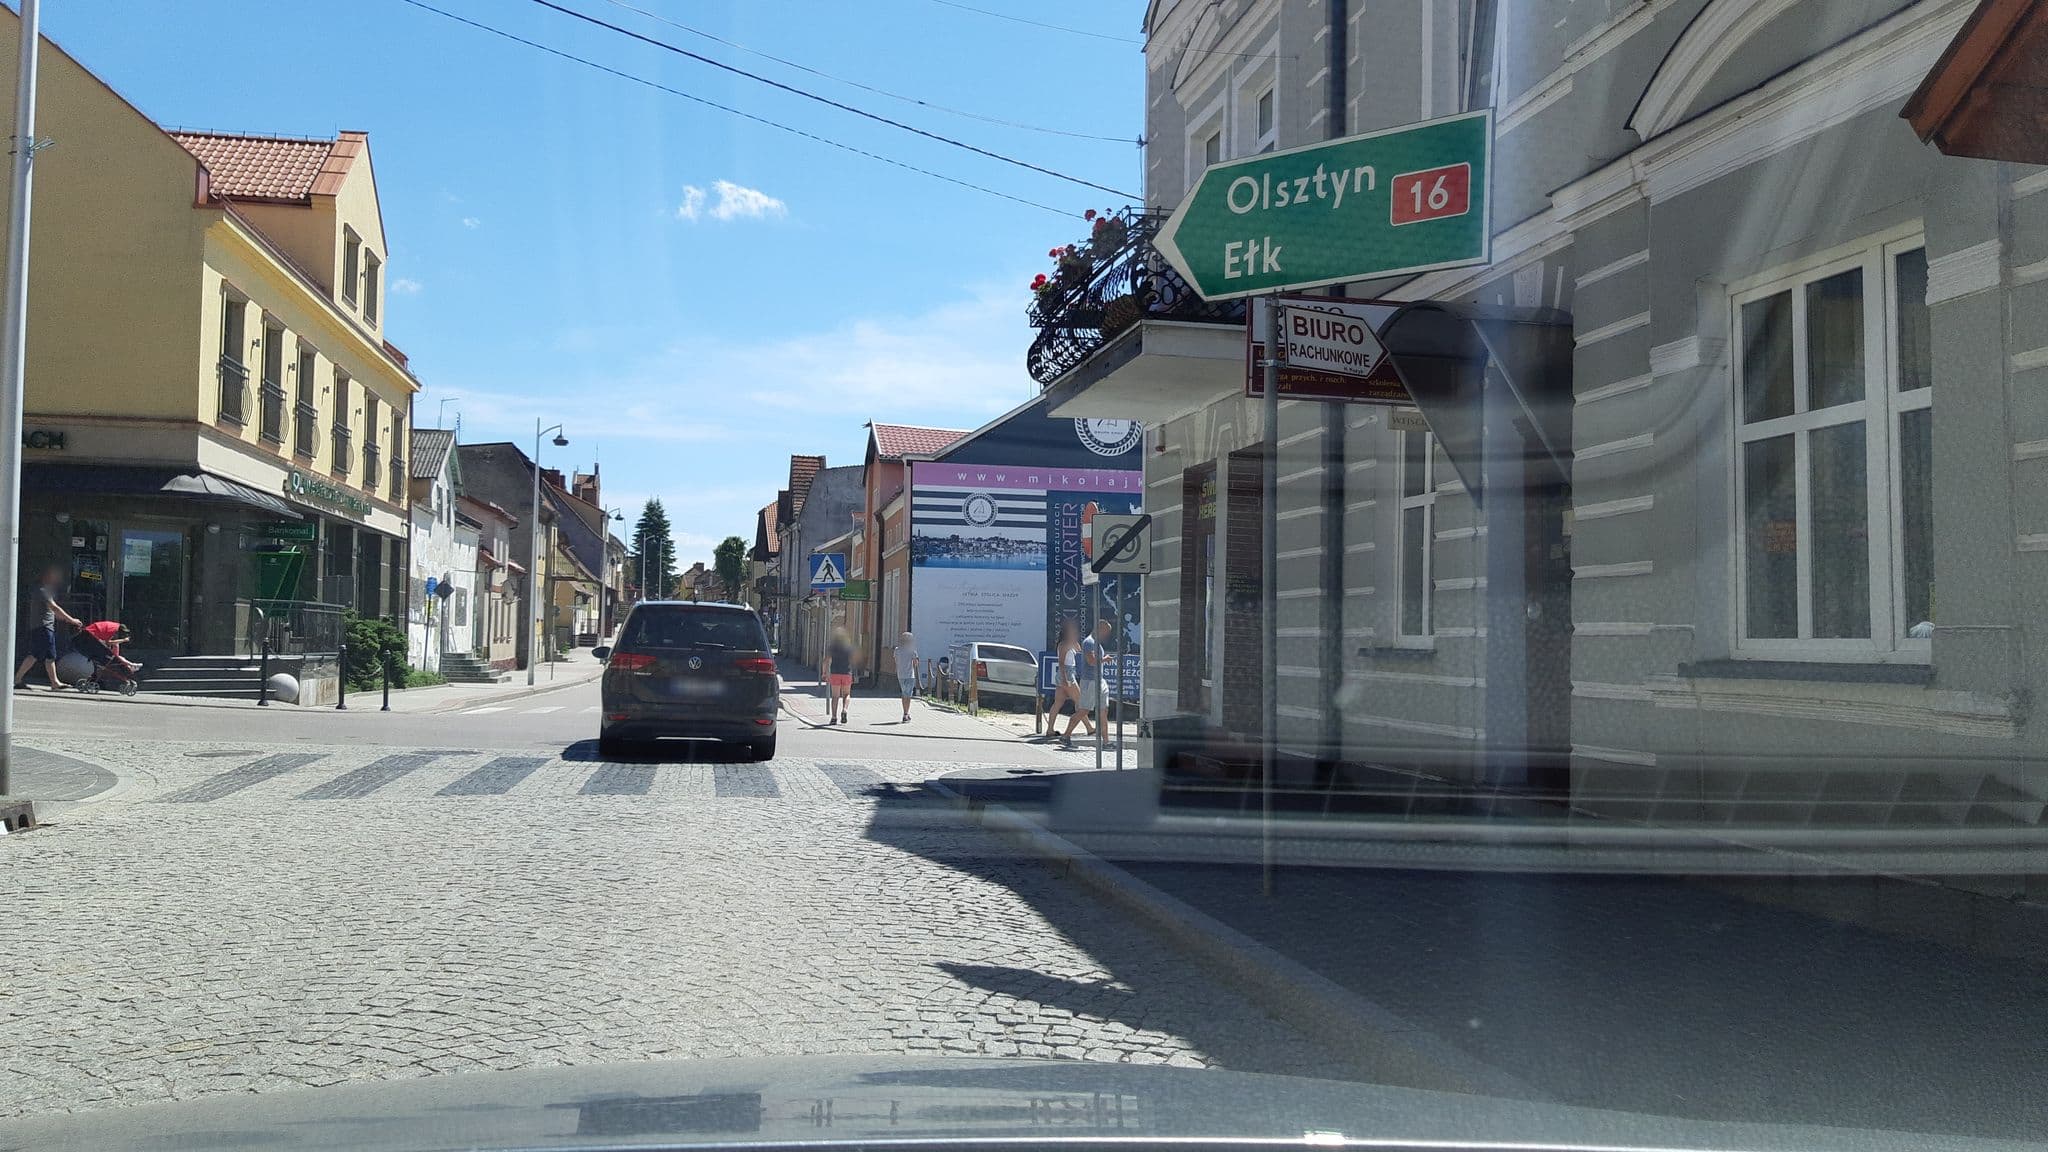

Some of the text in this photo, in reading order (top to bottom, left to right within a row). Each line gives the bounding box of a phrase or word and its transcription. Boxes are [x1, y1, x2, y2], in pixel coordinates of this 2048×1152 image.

[1226, 162, 1377, 214] Olsztyn
[1409, 174, 1449, 214] 16
[1224, 237, 1283, 280] Ełk
[1293, 315, 1364, 345] BIURO
[1290, 342, 1370, 368] RACHUNKOWE
[268, 526, 309, 537] Bankomat
[1054, 502, 1062, 565] mazurach
[1062, 502, 1078, 600] CZARTER
